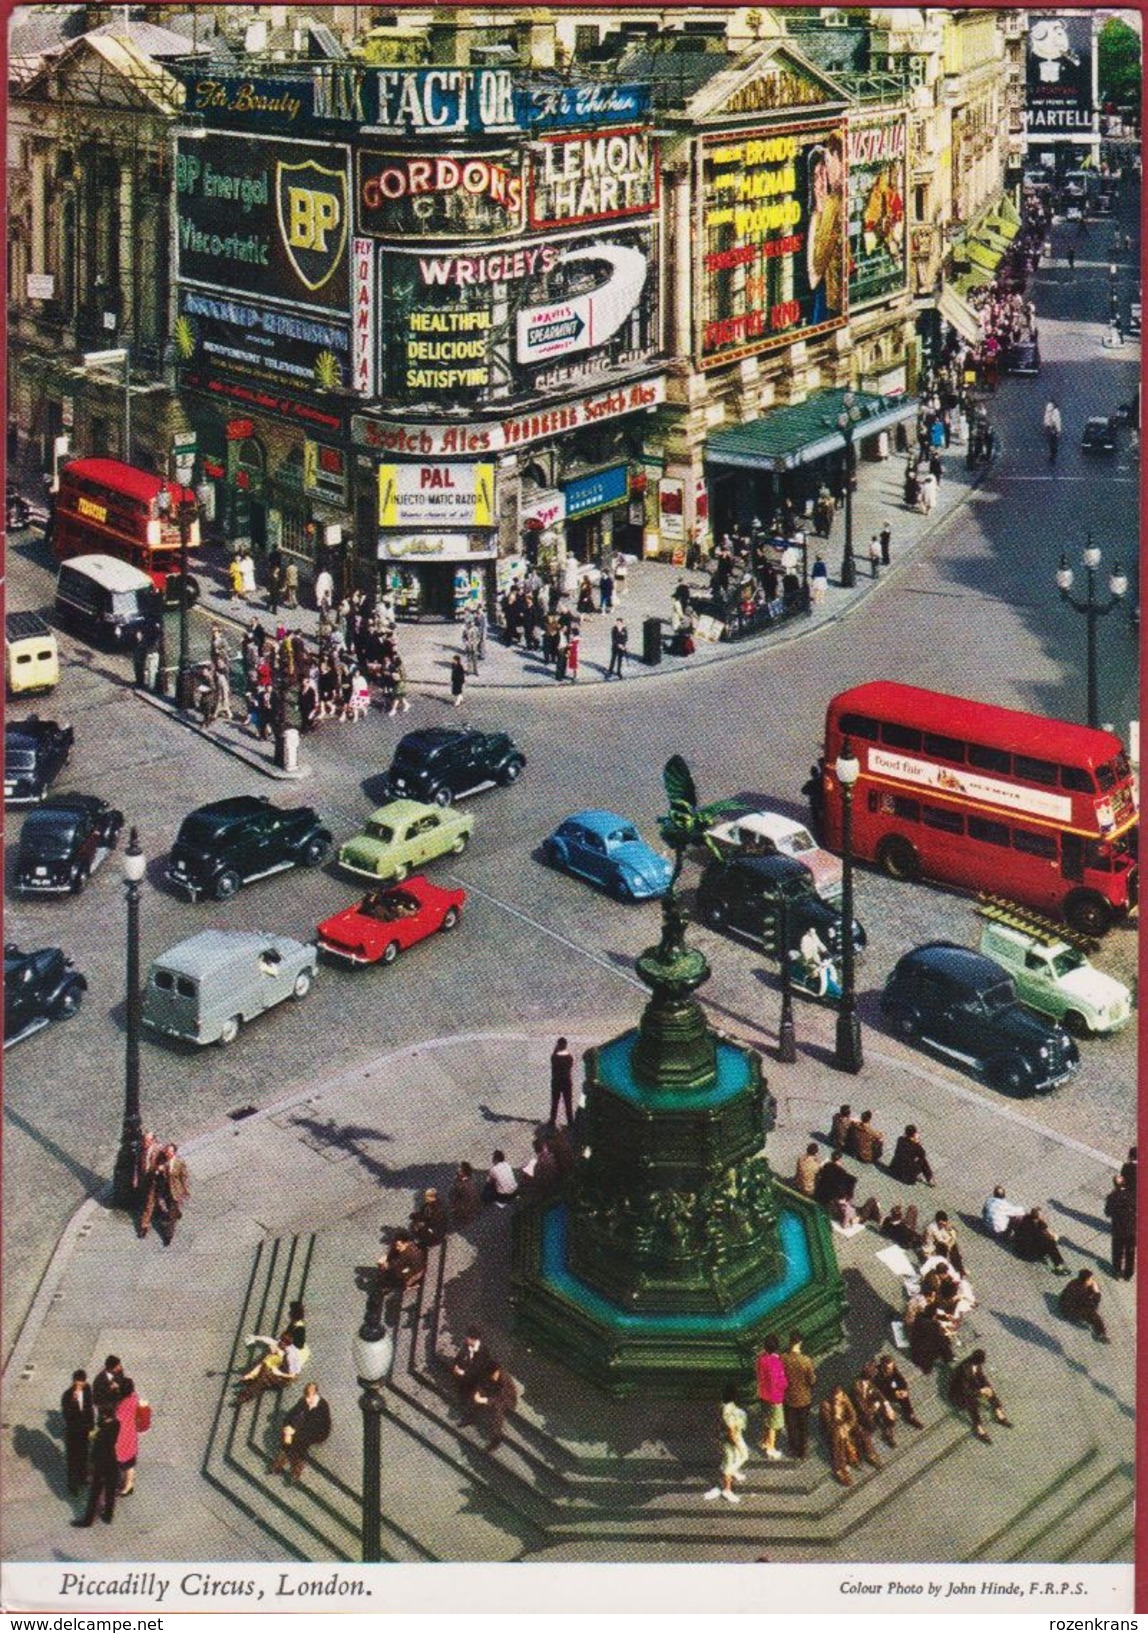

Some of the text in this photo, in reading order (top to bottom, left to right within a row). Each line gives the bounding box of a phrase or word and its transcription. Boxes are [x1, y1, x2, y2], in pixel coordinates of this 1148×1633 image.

[376, 70, 515, 127] FACTOR
[1021, 110, 1092, 126] MARTELL
[545, 136, 648, 181] LEMON
[555, 172, 640, 219] HART
[289, 187, 340, 252] BP
[354, 241, 372, 254] FLY
[419, 245, 557, 286] WRIGLEY'S
[410, 312, 493, 332] HEALTHFUL
[407, 339, 486, 360] DELICIOUS
[406, 367, 489, 389] SATISFYING
[440, 427, 491, 452] Ales
[583, 390, 627, 421] Scotch
[420, 467, 455, 489] PAL
[456, 494, 483, 504] RAZOR
